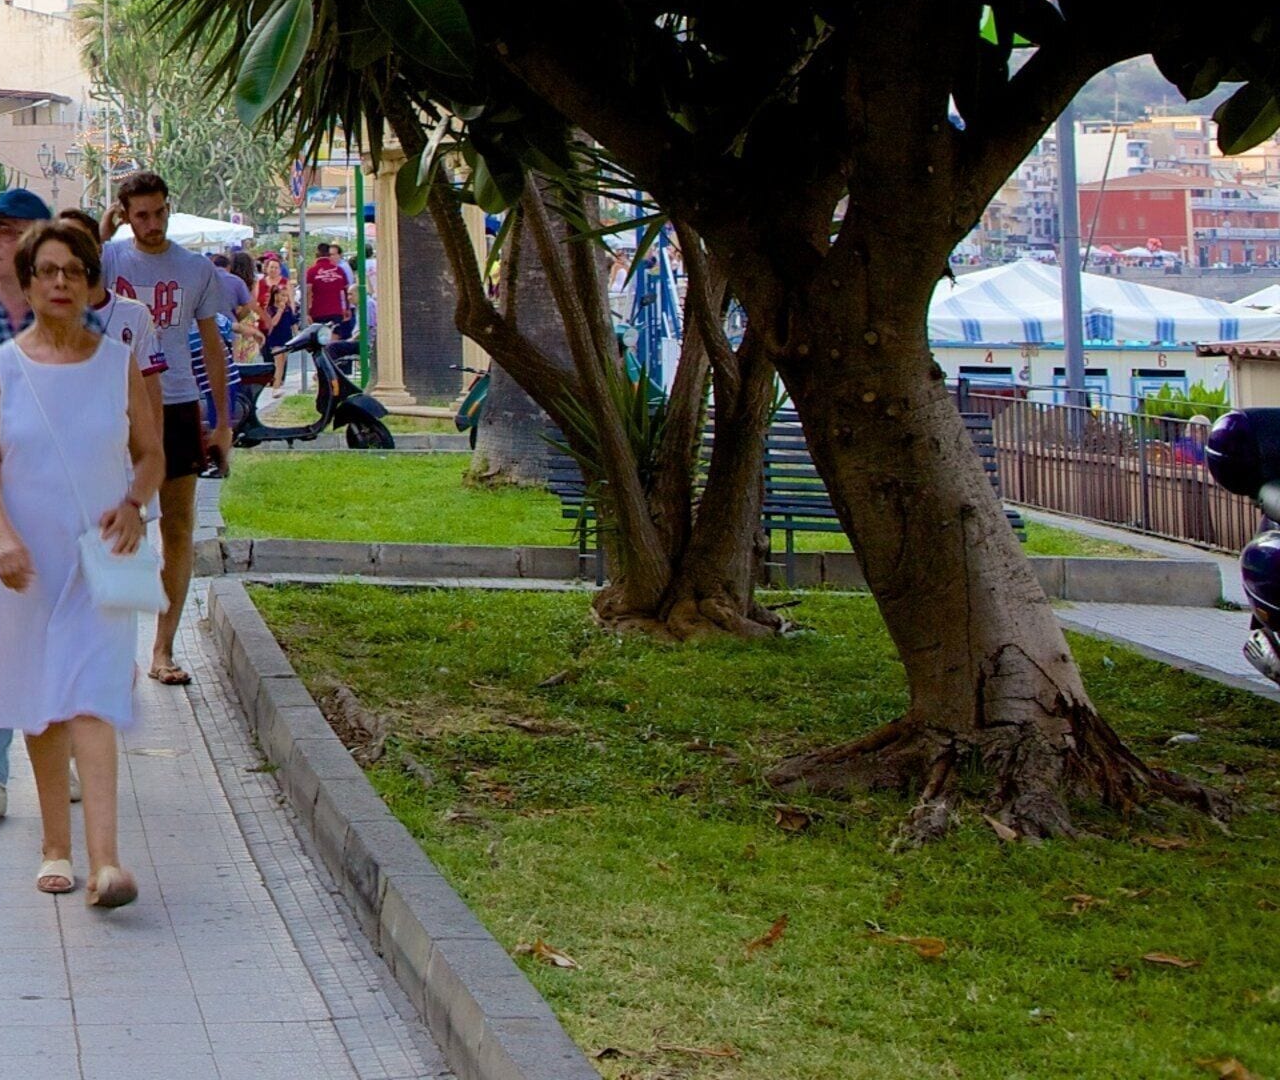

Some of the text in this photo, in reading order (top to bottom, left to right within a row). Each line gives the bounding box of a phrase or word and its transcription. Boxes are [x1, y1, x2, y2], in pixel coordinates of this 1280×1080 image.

[115, 276, 179, 327] Dff
[985, 351, 993, 363] 4
[1158, 353, 1167, 368] 6
